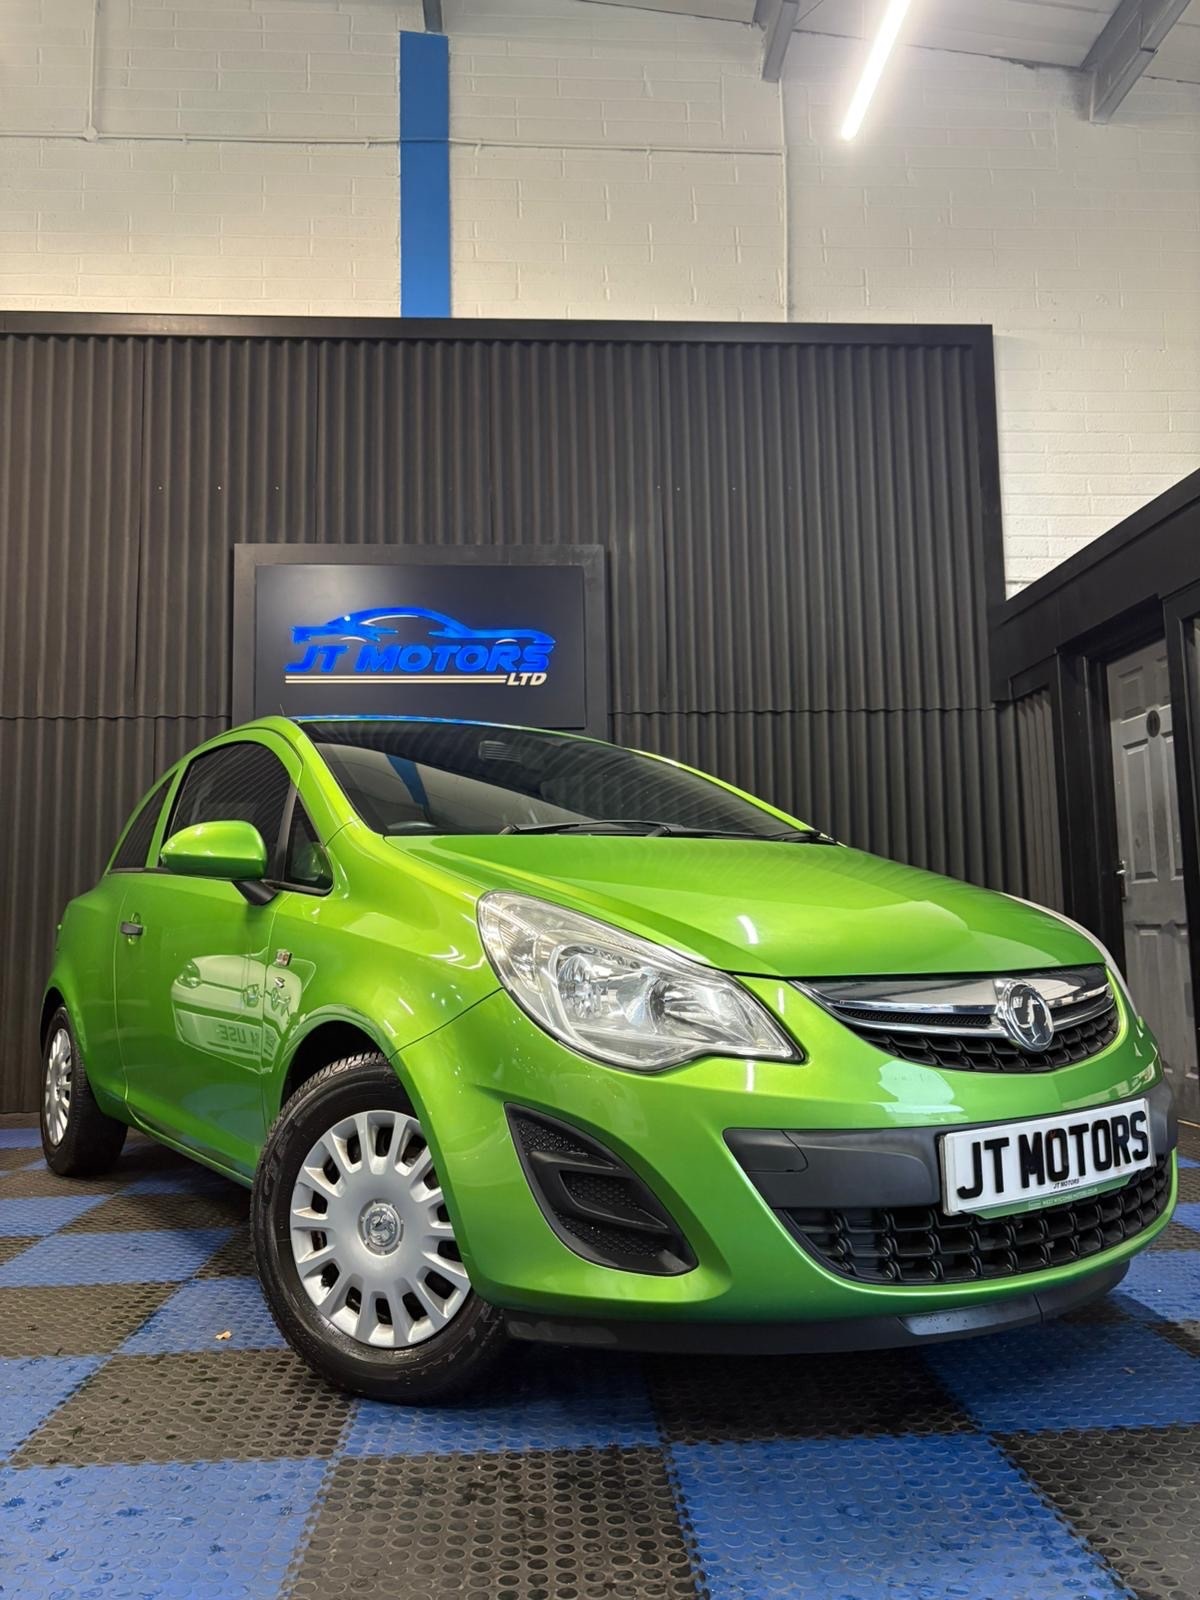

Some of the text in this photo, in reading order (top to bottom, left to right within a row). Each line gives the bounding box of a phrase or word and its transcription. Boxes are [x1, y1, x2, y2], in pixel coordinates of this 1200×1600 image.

[285, 644, 552, 672] JT MOTORS
[507, 672, 547, 686] LTD
[957, 1110, 1149, 1199] JT MOTORS
[1061, 1178, 1079, 1187] MOTORS
